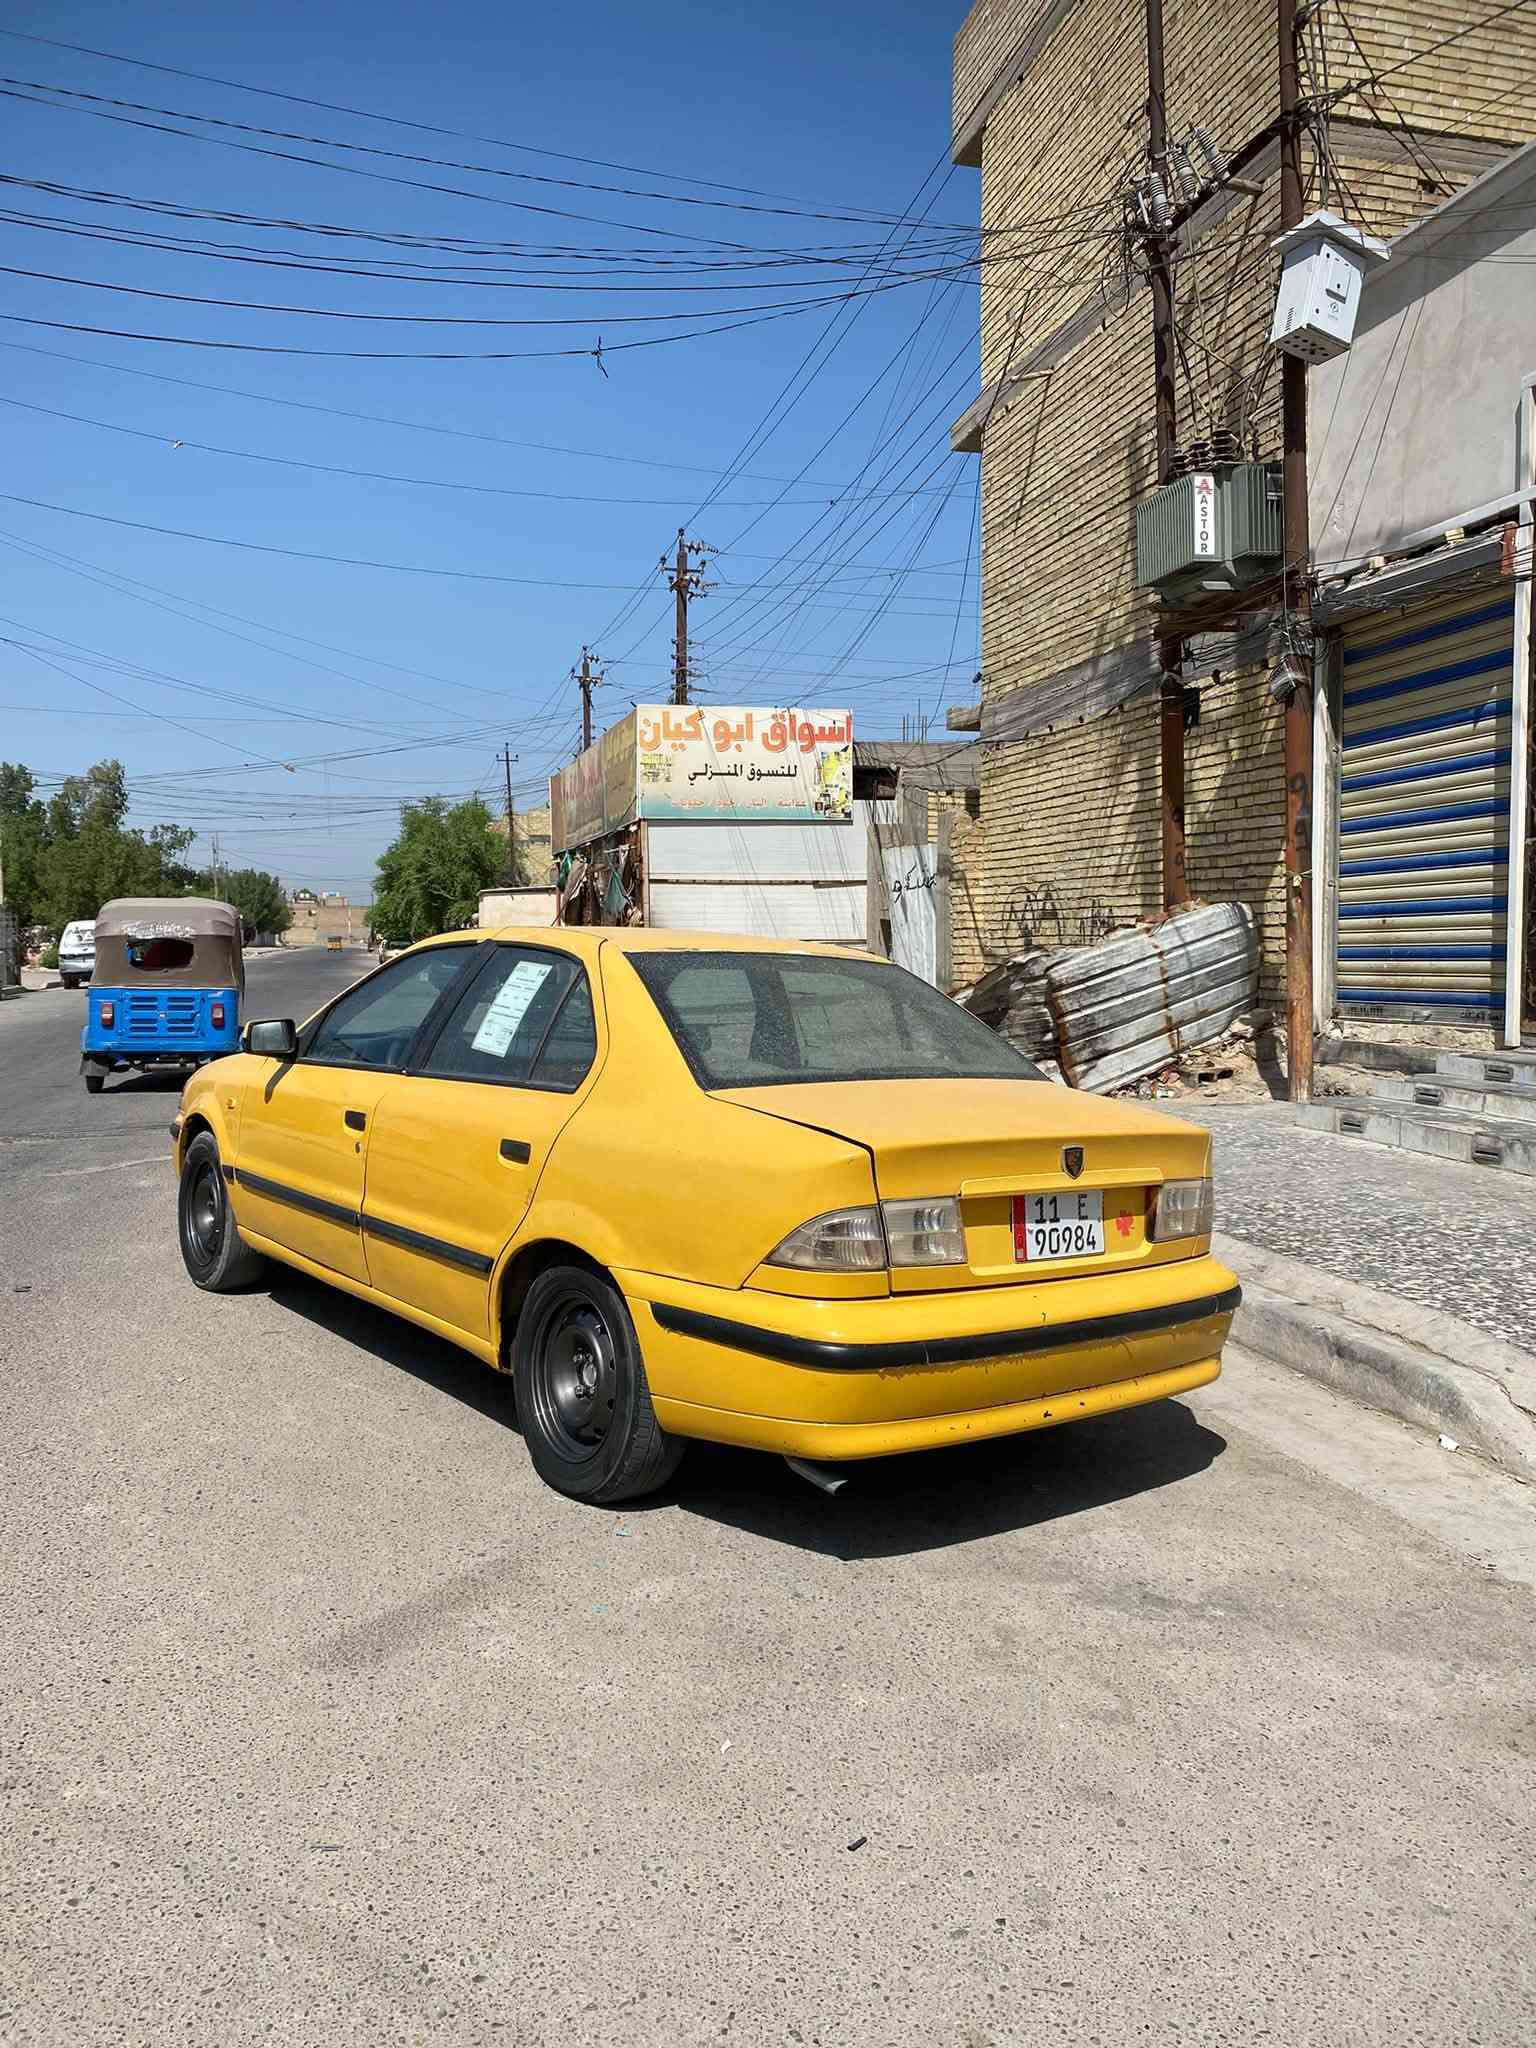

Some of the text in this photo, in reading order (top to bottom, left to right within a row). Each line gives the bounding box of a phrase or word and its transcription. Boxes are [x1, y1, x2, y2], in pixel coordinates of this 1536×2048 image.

[1199, 495, 1209, 553] ASTOR
[639, 709, 852, 752] اسواق ابو كيان
[747, 763, 798, 781] للتسوق
[1034, 1193, 1088, 1224] 11 E
[1035, 1224, 1097, 1256] 90984
